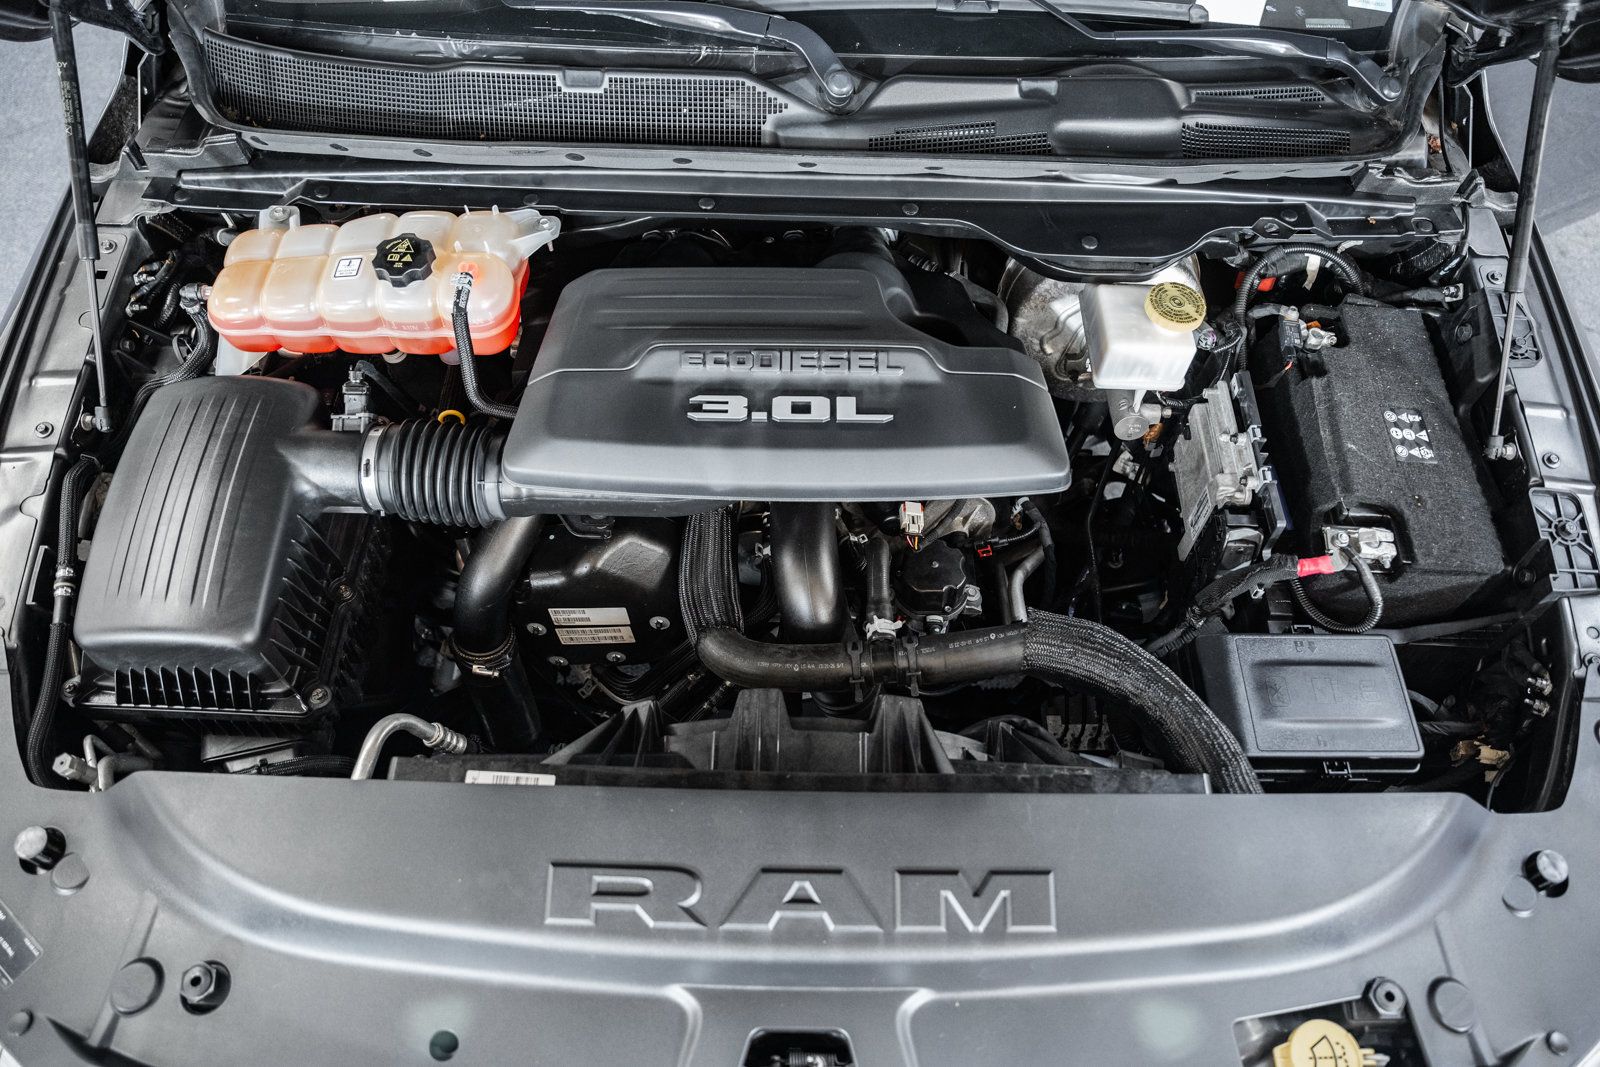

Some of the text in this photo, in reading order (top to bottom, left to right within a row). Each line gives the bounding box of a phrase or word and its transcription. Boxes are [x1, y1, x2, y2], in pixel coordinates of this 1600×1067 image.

[681, 351, 904, 376] ECODIESEL
[687, 394, 894, 423] 3.0L
[544, 861, 1057, 932] RAM
